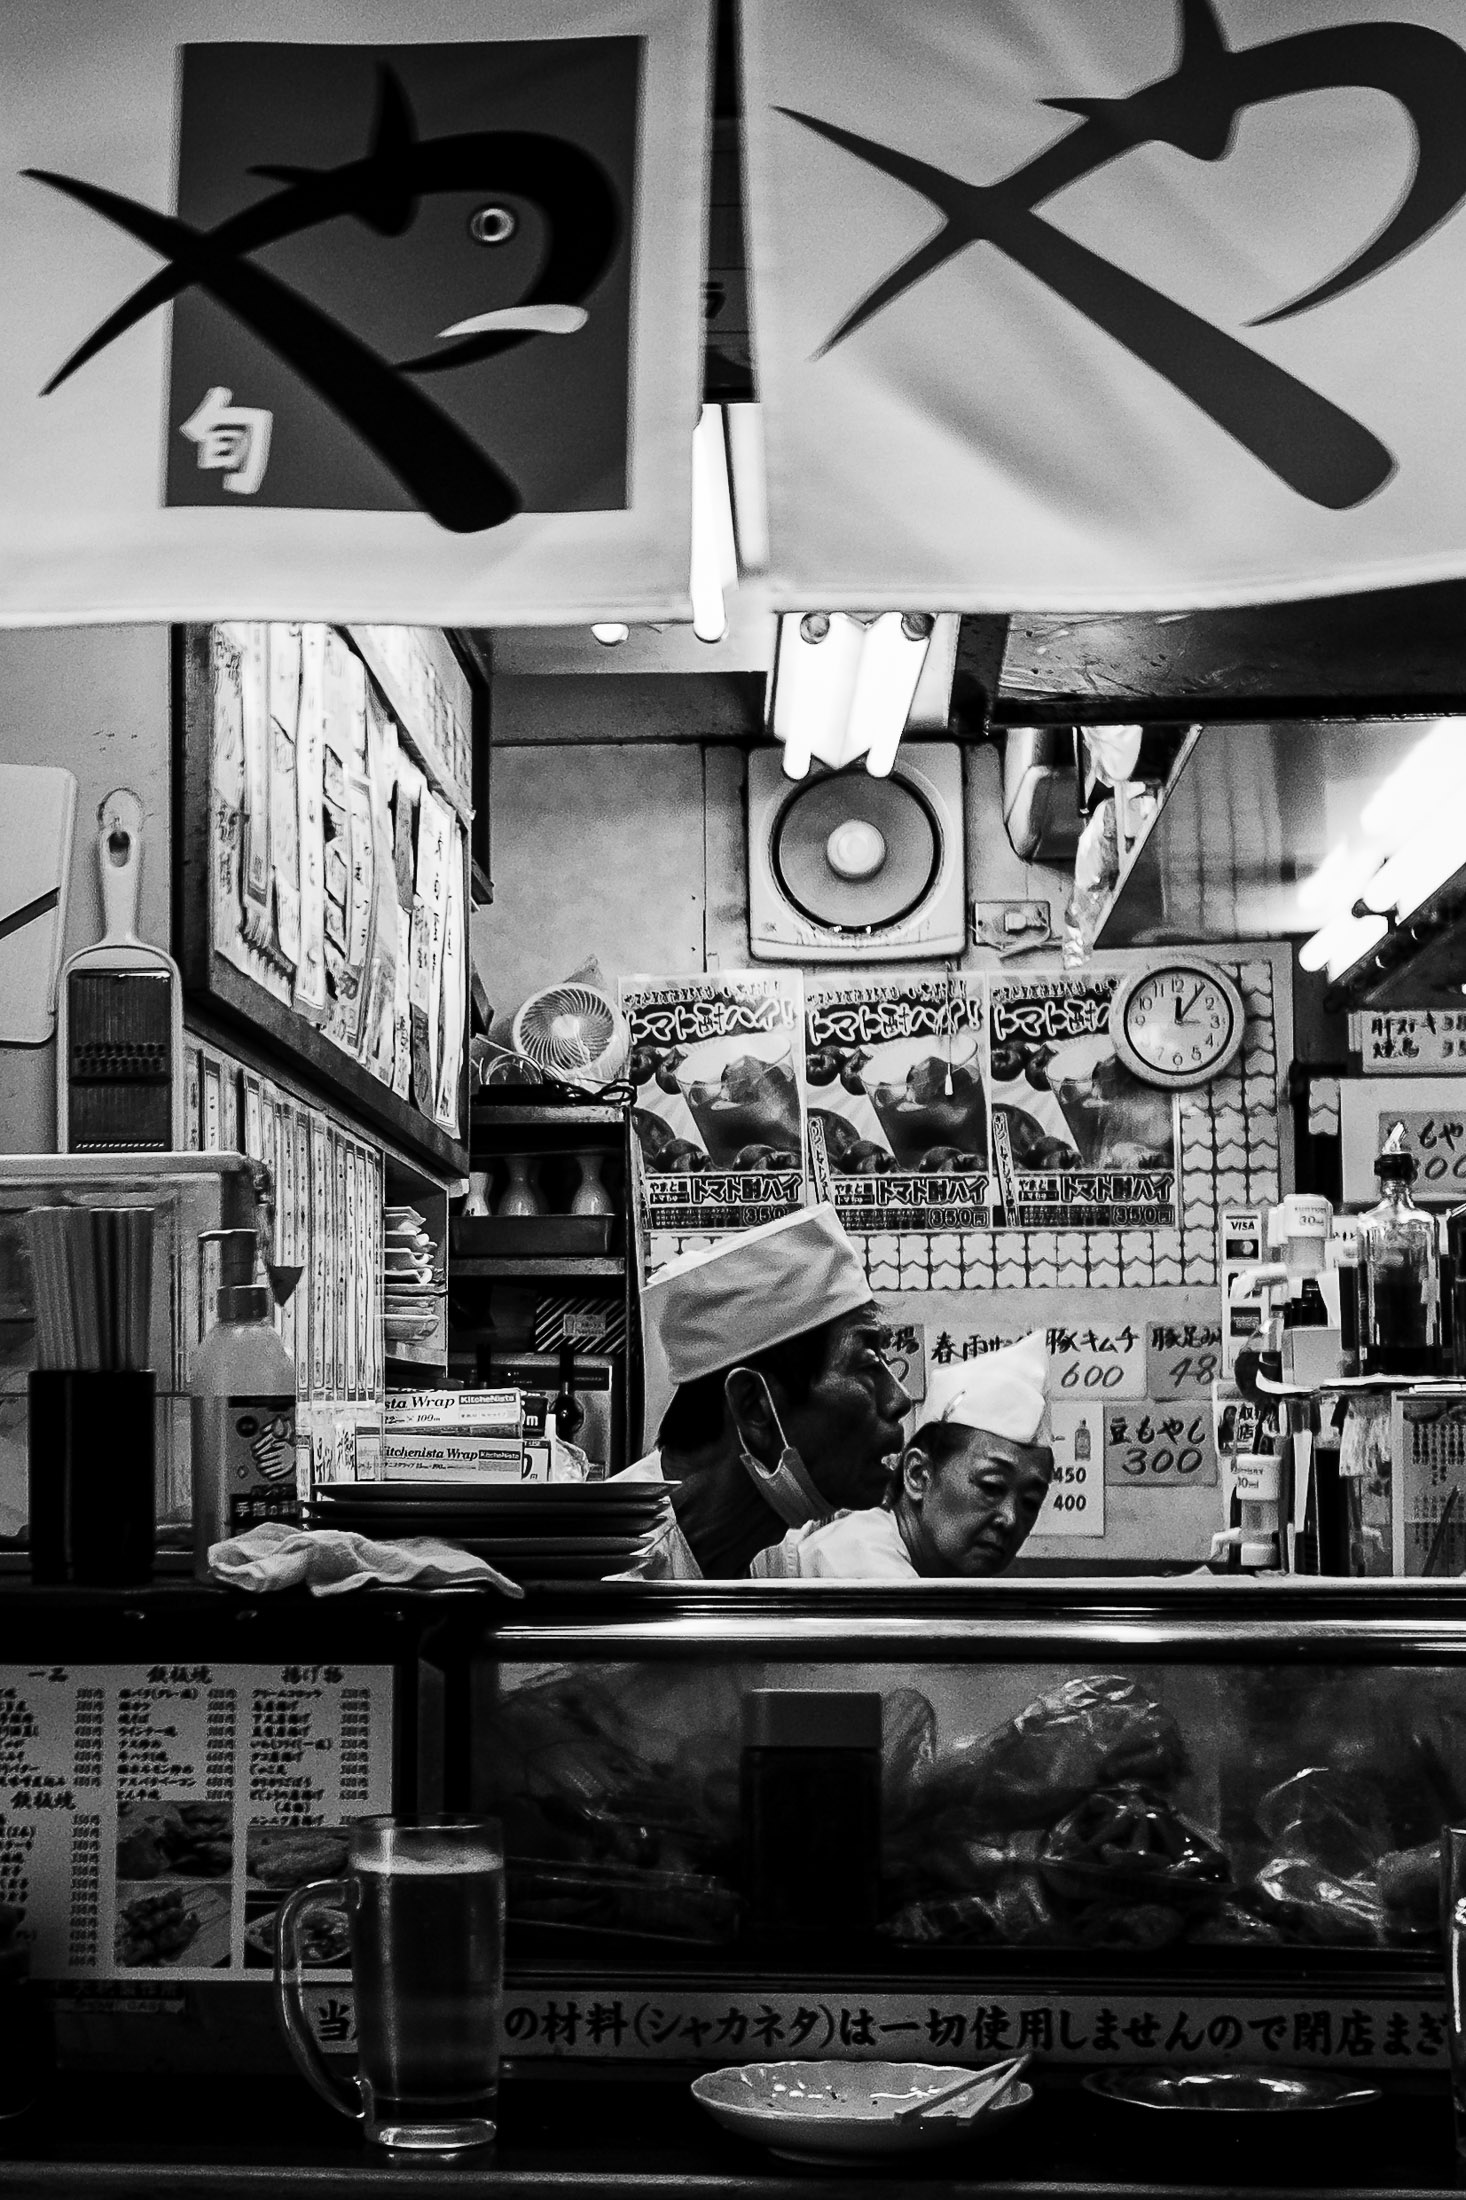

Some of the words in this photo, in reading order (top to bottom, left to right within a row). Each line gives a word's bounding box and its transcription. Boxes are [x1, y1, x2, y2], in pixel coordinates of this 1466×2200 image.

[180, 386, 274, 495] 旬
[1230, 1220, 1256, 1231] VISA
[1045, 1325, 1141, 1356] 豚キムチ
[1060, 1361, 1125, 1389] 600
[412, 1396, 455, 1410] Wrap
[1108, 1414, 1206, 1447] 豆もやし
[446, 1448, 479, 1462] Wrap
[1121, 1446, 1203, 1476] 300
[1052, 1493, 1087, 1512] 400
